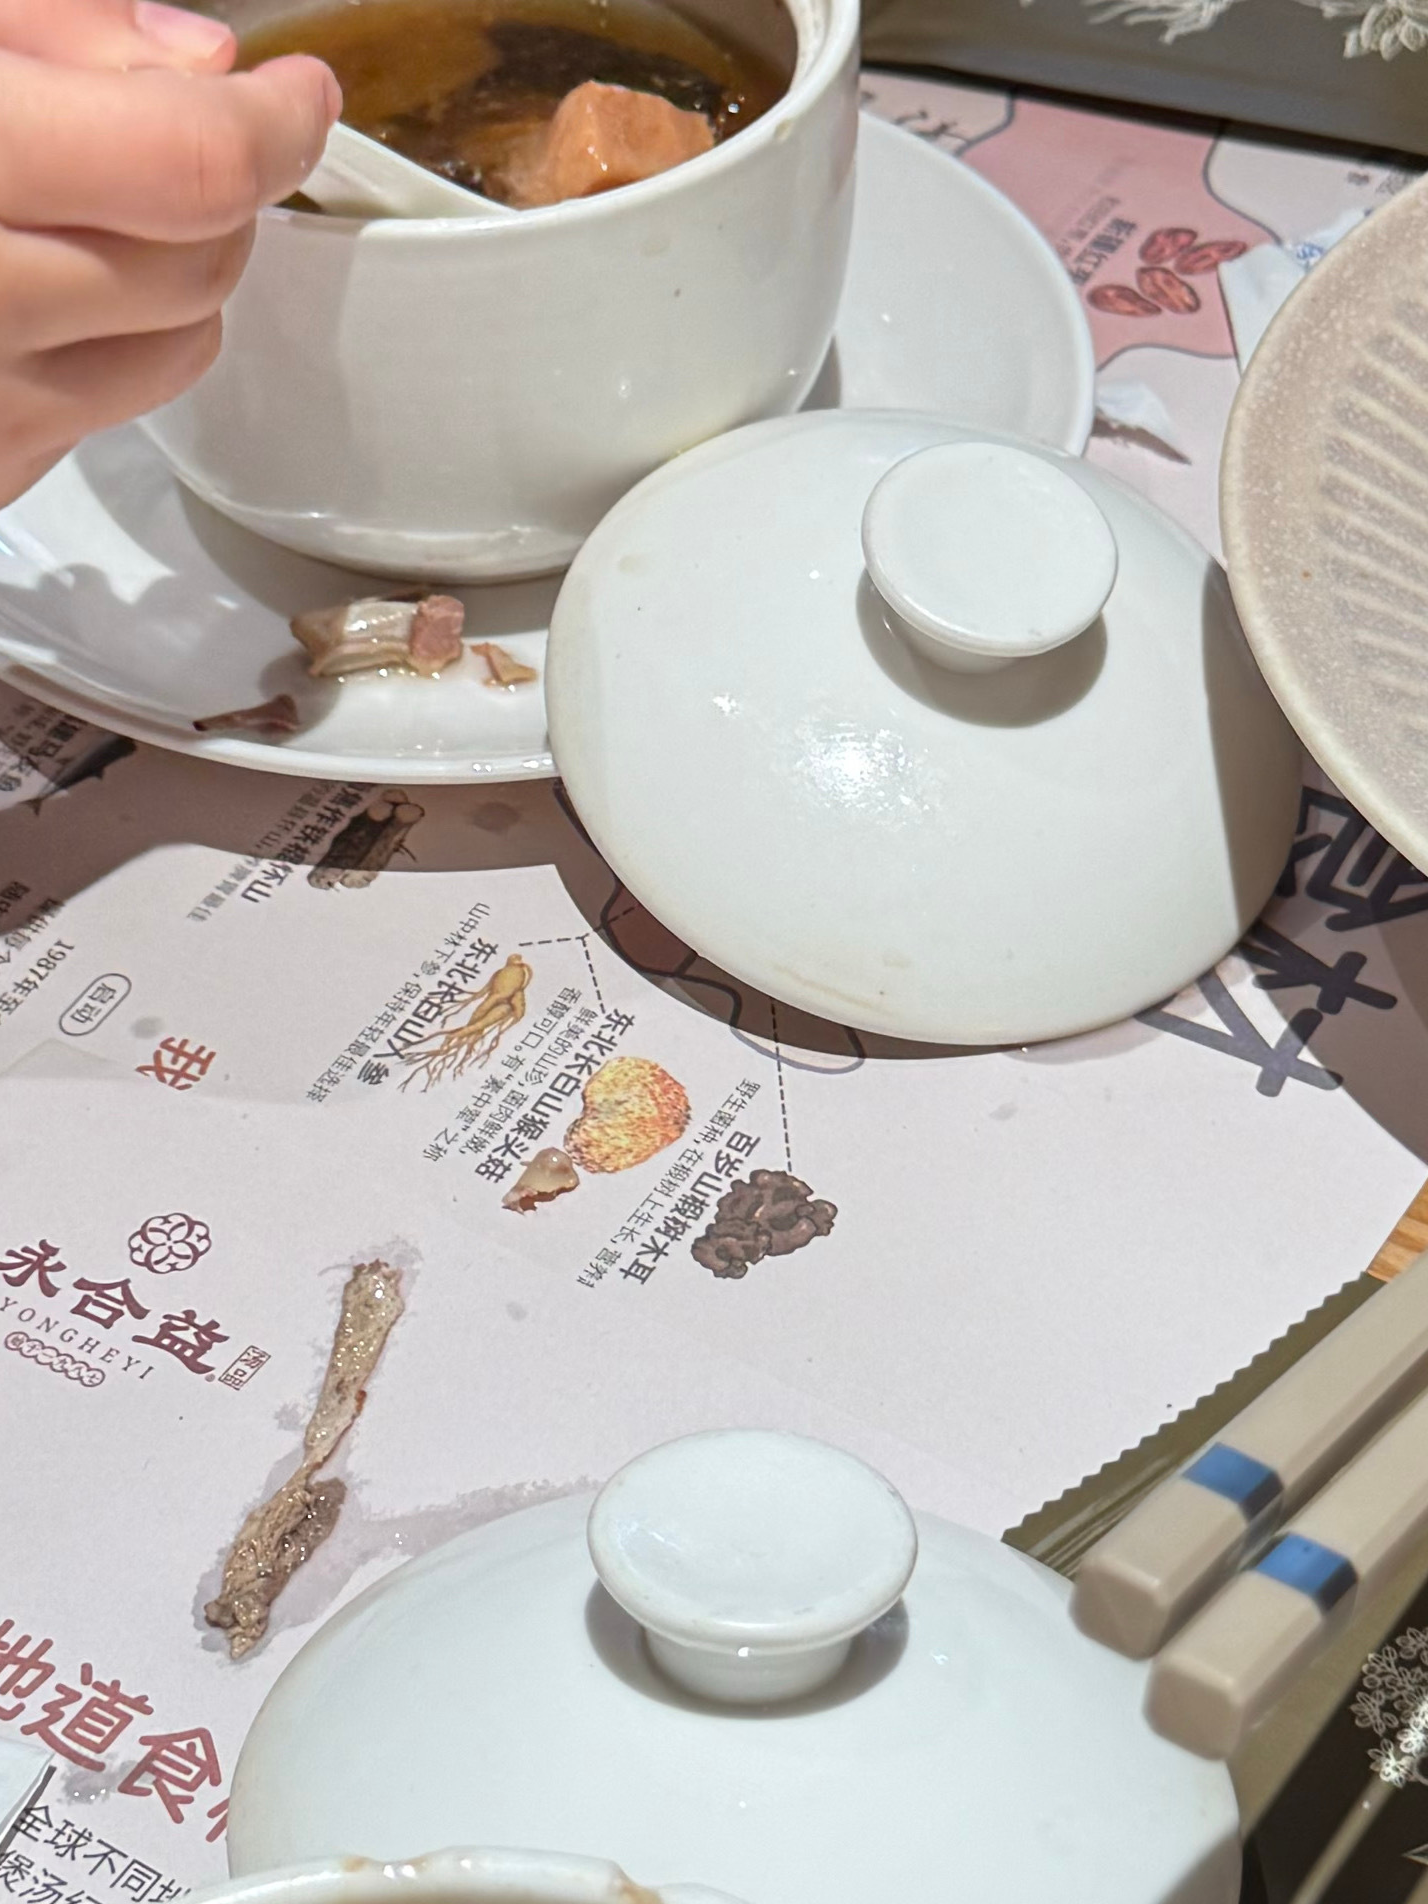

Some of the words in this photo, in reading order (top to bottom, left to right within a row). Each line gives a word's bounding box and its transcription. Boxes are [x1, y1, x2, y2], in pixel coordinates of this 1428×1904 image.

[75, 984, 119, 1034] 启动
[134, 1036, 218, 1092] 我
[353, 937, 499, 1092] 东北长白山人参
[474, 1007, 637, 1185] 东北长白山猴头菇
[619, 1127, 762, 1285] 百岁山椴树木耳
